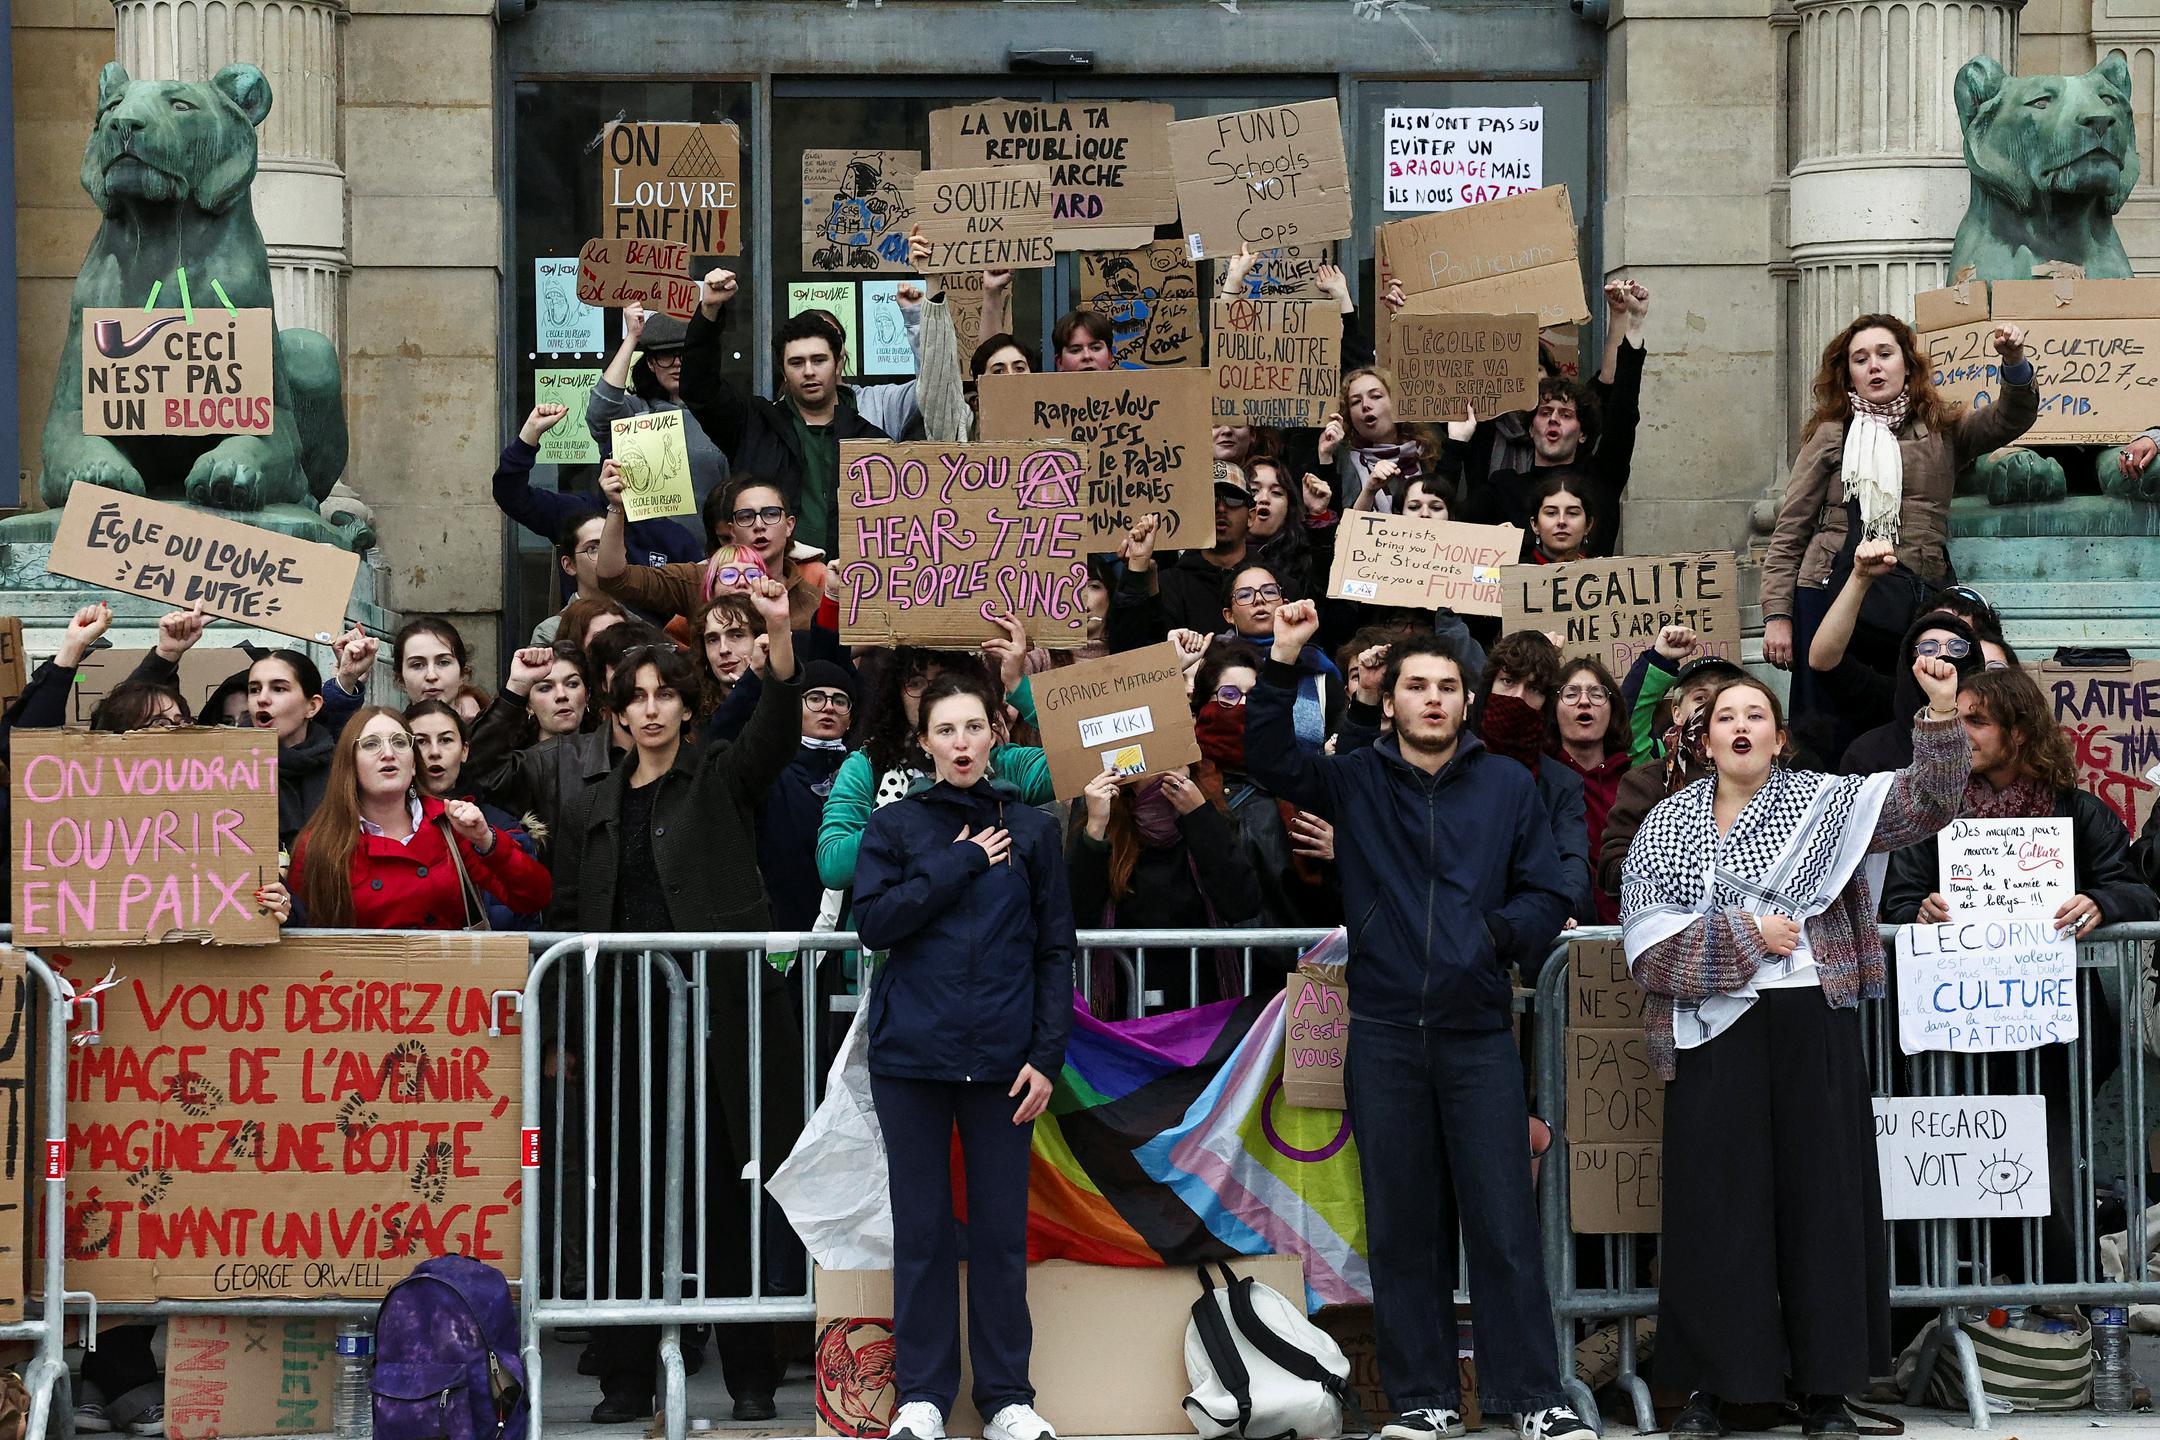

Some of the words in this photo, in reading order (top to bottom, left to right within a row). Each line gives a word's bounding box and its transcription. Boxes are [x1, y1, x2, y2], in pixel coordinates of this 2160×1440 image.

[961, 113, 990, 135] LA
[1083, 107, 1109, 128] TA
[1217, 108, 1299, 147] FUND
[1478, 117, 1515, 133] PAS
[1520, 118, 1539, 132] SU
[611, 126, 659, 166] ON
[986, 134, 1128, 161] REPUBLIQUE
[1390, 136, 1456, 156] EVITER
[1468, 140, 1492, 156] UN
[1207, 144, 1309, 185] Schools
[1389, 159, 1487, 177] BRAQUAGE
[1492, 158, 1531, 179] MAIS
[609, 168, 737, 208] LOUVRE
[933, 181, 1041, 214] SOUTIEN
[1246, 173, 1301, 204] NOT
[1390, 185, 1408, 204] ILS
[1416, 187, 1453, 204] NOUS
[967, 217, 1004, 233] AUX
[1237, 208, 1297, 243] Cops
[625, 241, 687, 270] BEAUTÉ
[577, 281, 606, 301] est
[612, 280, 647, 300] dans
[651, 279, 661, 299] la
[667, 281, 696, 313] RUE
[941, 276, 963, 290] ALL
[1155, 321, 1172, 334] DE
[1213, 297, 1277, 333] L'ART
[1283, 301, 1312, 334] EST
[164, 322, 236, 361] CECI
[1274, 337, 1329, 366] NOTRE
[1403, 325, 1485, 355] L'ÉCOLE
[1492, 331, 1522, 352] DU
[88, 363, 170, 394] N'EST
[187, 363, 242, 394] PAS
[1219, 361, 1294, 392] COLÈRE
[1298, 365, 1337, 397] AUSSI
[1398, 358, 1475, 379] LOUVRE
[1483, 359, 1508, 377] VA
[1456, 377, 1525, 395] REFAIRE
[103, 399, 145, 430] UN
[165, 397, 271, 429] BLOCUS
[1243, 396, 1295, 417] SOUTIENT
[1399, 397, 1417, 416] LE
[1422, 394, 1502, 417] PORTRAIT
[1072, 422, 1144, 448] QU'ICI
[847, 454, 929, 507] DO
[939, 453, 1010, 504] YOU
[857, 508, 976, 565] HEAR
[988, 507, 1083, 560] THE
[1360, 516, 1436, 541] Tourists
[87, 503, 163, 554] ÉCOLE
[165, 535, 202, 562] DU
[205, 540, 303, 586] LOUVRE
[1375, 537, 1404, 551] bring
[1410, 545, 1426, 553] you
[1432, 543, 1507, 567] MONEY
[1352, 550, 1382, 563] But
[1390, 555, 1462, 575] Students
[1357, 566, 1389, 582] Give
[1390, 576, 1412, 585] you
[134, 564, 174, 596] EN
[842, 556, 988, 626] PEOPLE
[979, 560, 1088, 629] SING?
[1523, 554, 1724, 613] L'ÉGALITÉ
[1567, 615, 1600, 644] NE
[1046, 681, 1110, 711] GRANDE
[1113, 667, 1177, 693] MATRAQUE
[1113, 713, 1146, 733] KIKI
[24, 754, 103, 803] ON
[113, 748, 278, 795] VOUDRAIT
[22, 808, 256, 871] LOUVRIR
[1951, 820, 1980, 841] Des
[1986, 826, 2025, 847] moyens
[2002, 843, 2017, 857] la
[2018, 841, 2060, 859] Culture
[1951, 864, 1972, 877] PAS
[1978, 864, 1995, 877] les
[1983, 882, 1995, 890] de
[2004, 878, 2041, 890] l'armée
[2047, 879, 2060, 887] ni
[23, 879, 96, 935] EN
[118, 863, 253, 932] PAIX
[1960, 901, 1976, 909] des
[1933, 973, 1944, 982] a
[1937, 956, 1968, 969] est
[133, 979, 269, 1032] VOUS
[285, 970, 442, 1033] DÉSIREZ
[447, 986, 524, 1036] UNE
[1293, 982, 1344, 1018] Ah
[1580, 987, 1608, 1018] NE
[1933, 979, 2073, 1012] CULTURE
[1291, 1018, 1349, 1040] c'est
[1924, 1020, 1951, 1033] dans
[1966, 1012, 1979, 1025] la
[2051, 1009, 2073, 1023] des
[1949, 1022, 2059, 1049] PATRONS
[67, 1045, 207, 1103] IMAGE
[229, 1047, 280, 1104] DE
[1577, 1034, 1650, 1087] PAS
[1911, 1109, 2006, 1139] REGARD
[255, 1122, 336, 1173] UNE
[344, 1122, 483, 1177] BOTTE
[1576, 1149, 1607, 1171] DU
[1905, 1152, 1967, 1187] VOIT
[262, 1208, 324, 1259] UN
[214, 1263, 292, 1292] GEORGE
